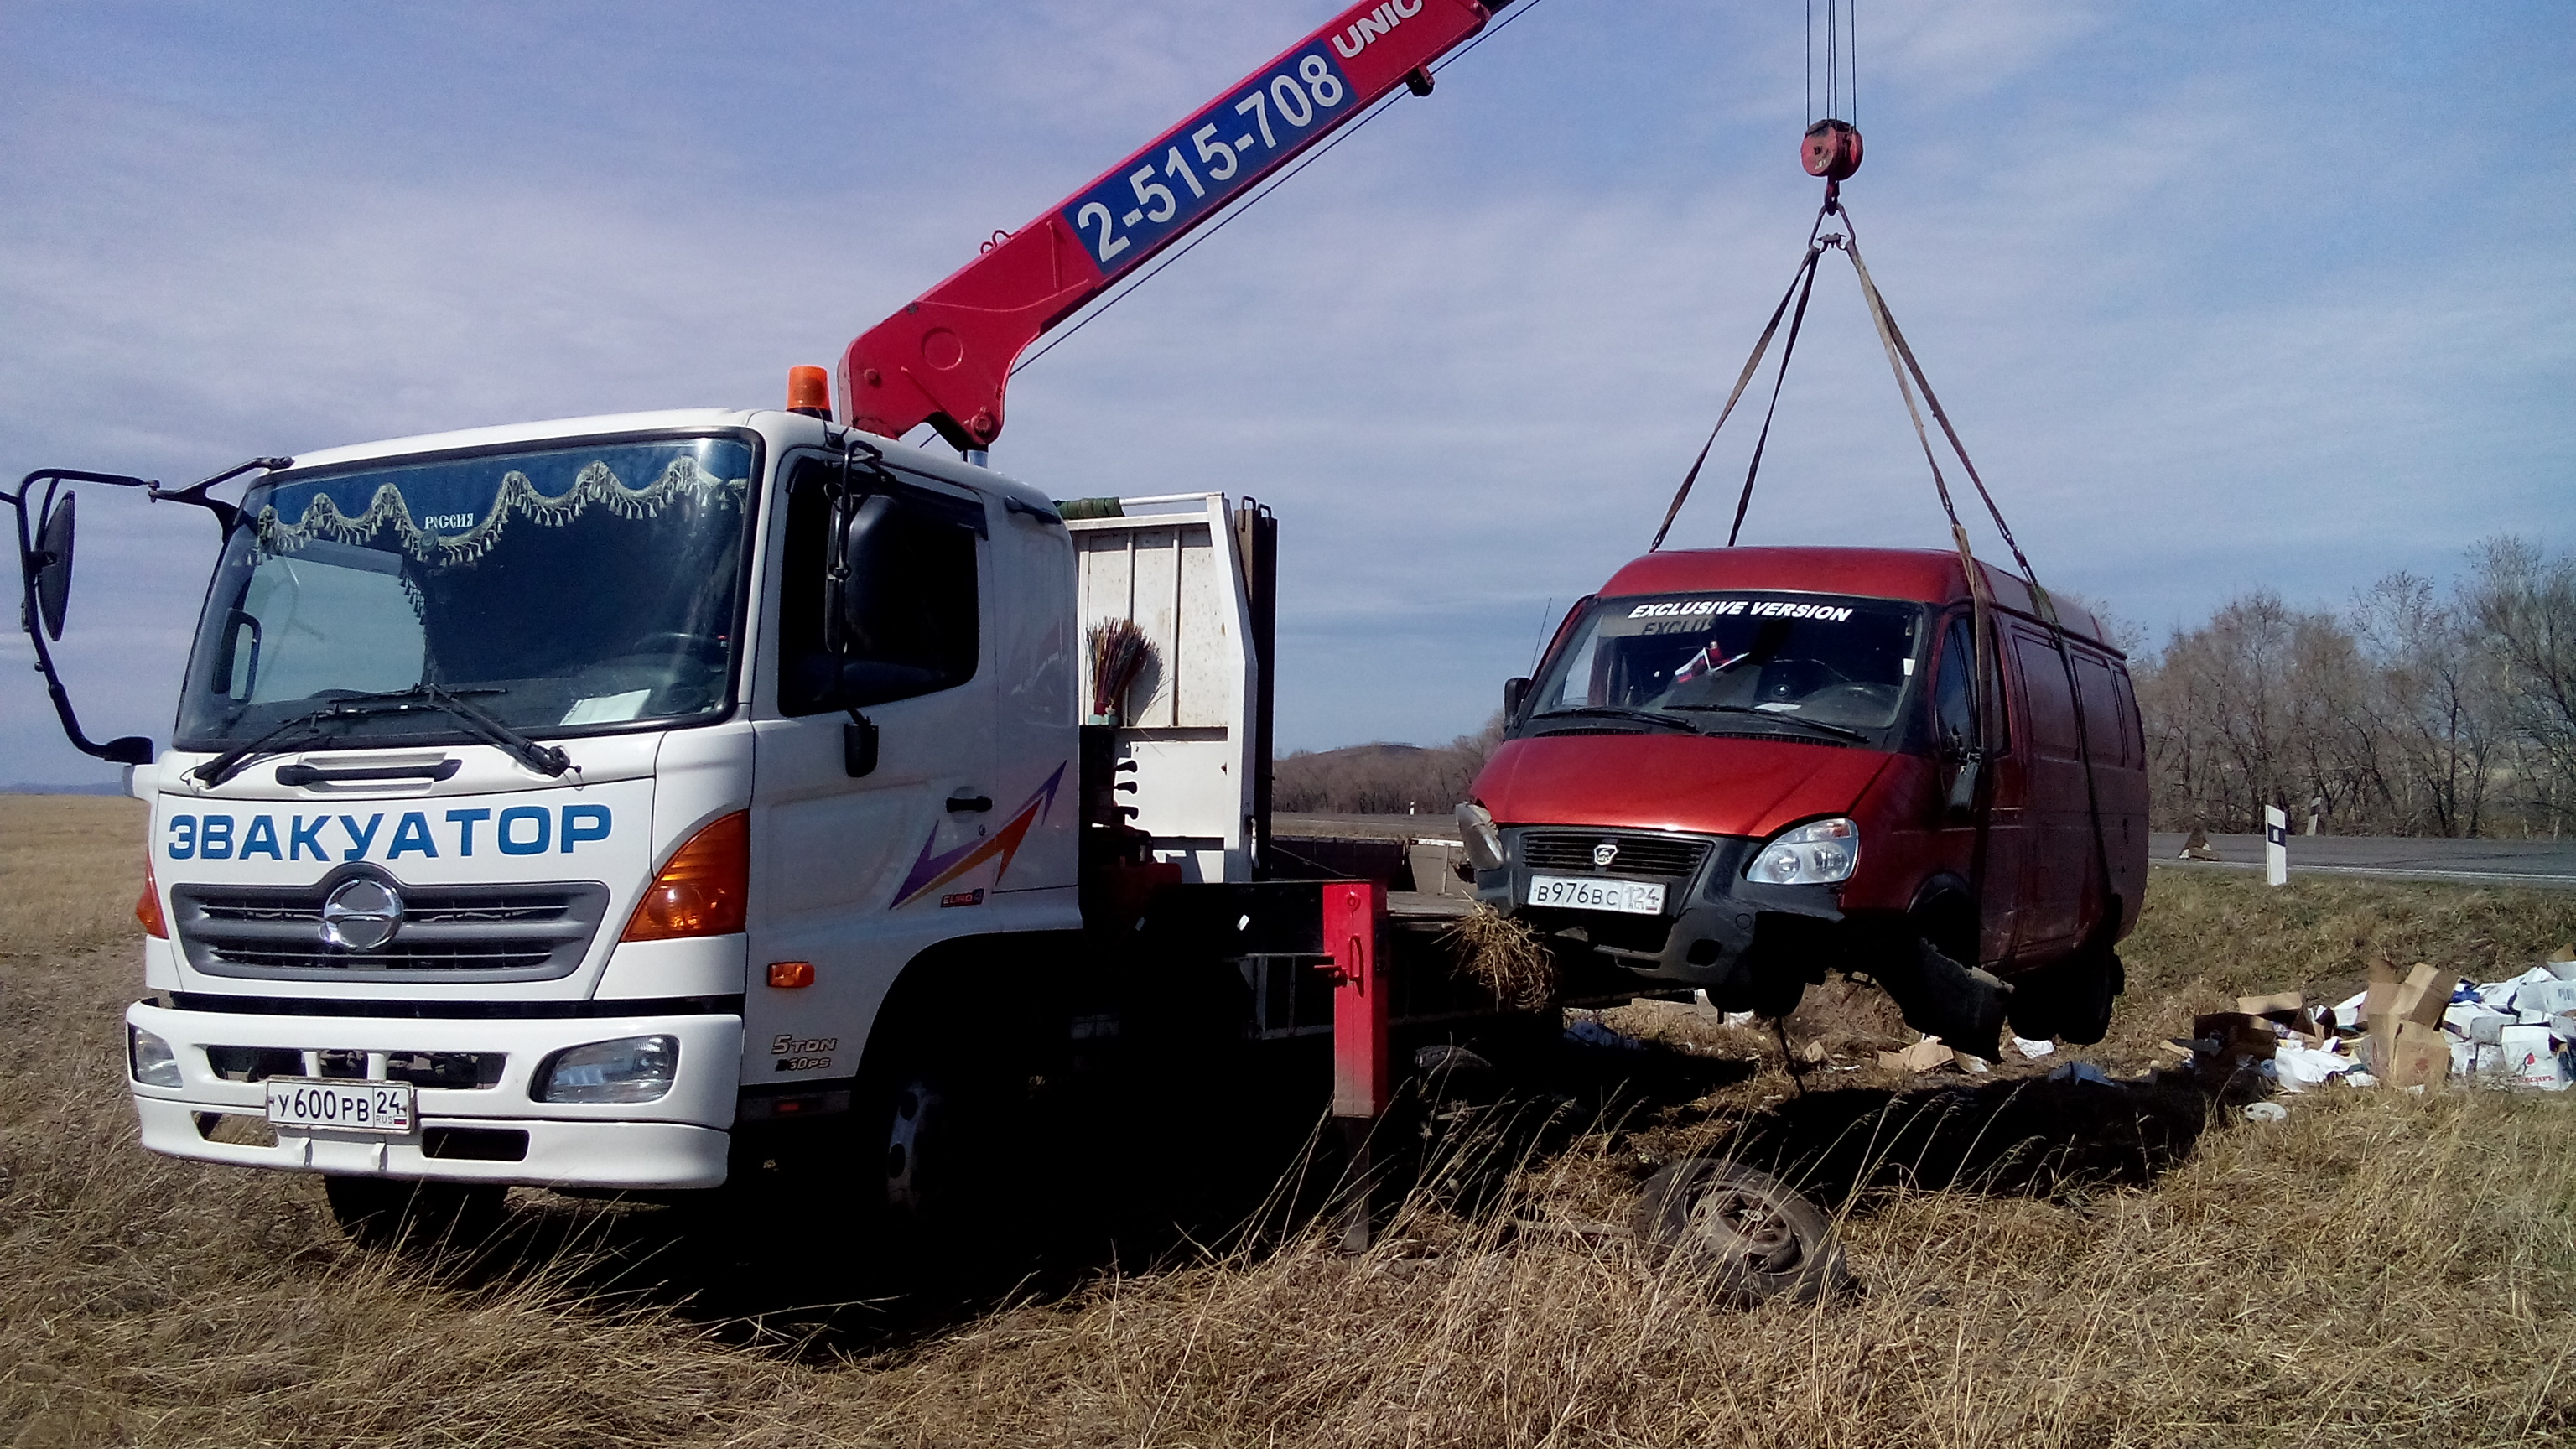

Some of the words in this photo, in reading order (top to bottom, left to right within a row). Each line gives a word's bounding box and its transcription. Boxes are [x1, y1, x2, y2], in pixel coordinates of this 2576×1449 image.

[1332, 0, 1423, 58] UNIC
[1078, 54, 1343, 263] 2-515-708
[1628, 601, 1748, 619] EXCLUSIVE
[1750, 602, 1852, 621] VERSION
[169, 804, 612, 862] ЭВАКУАТОР
[776, 1057, 831, 1071] 60PS
